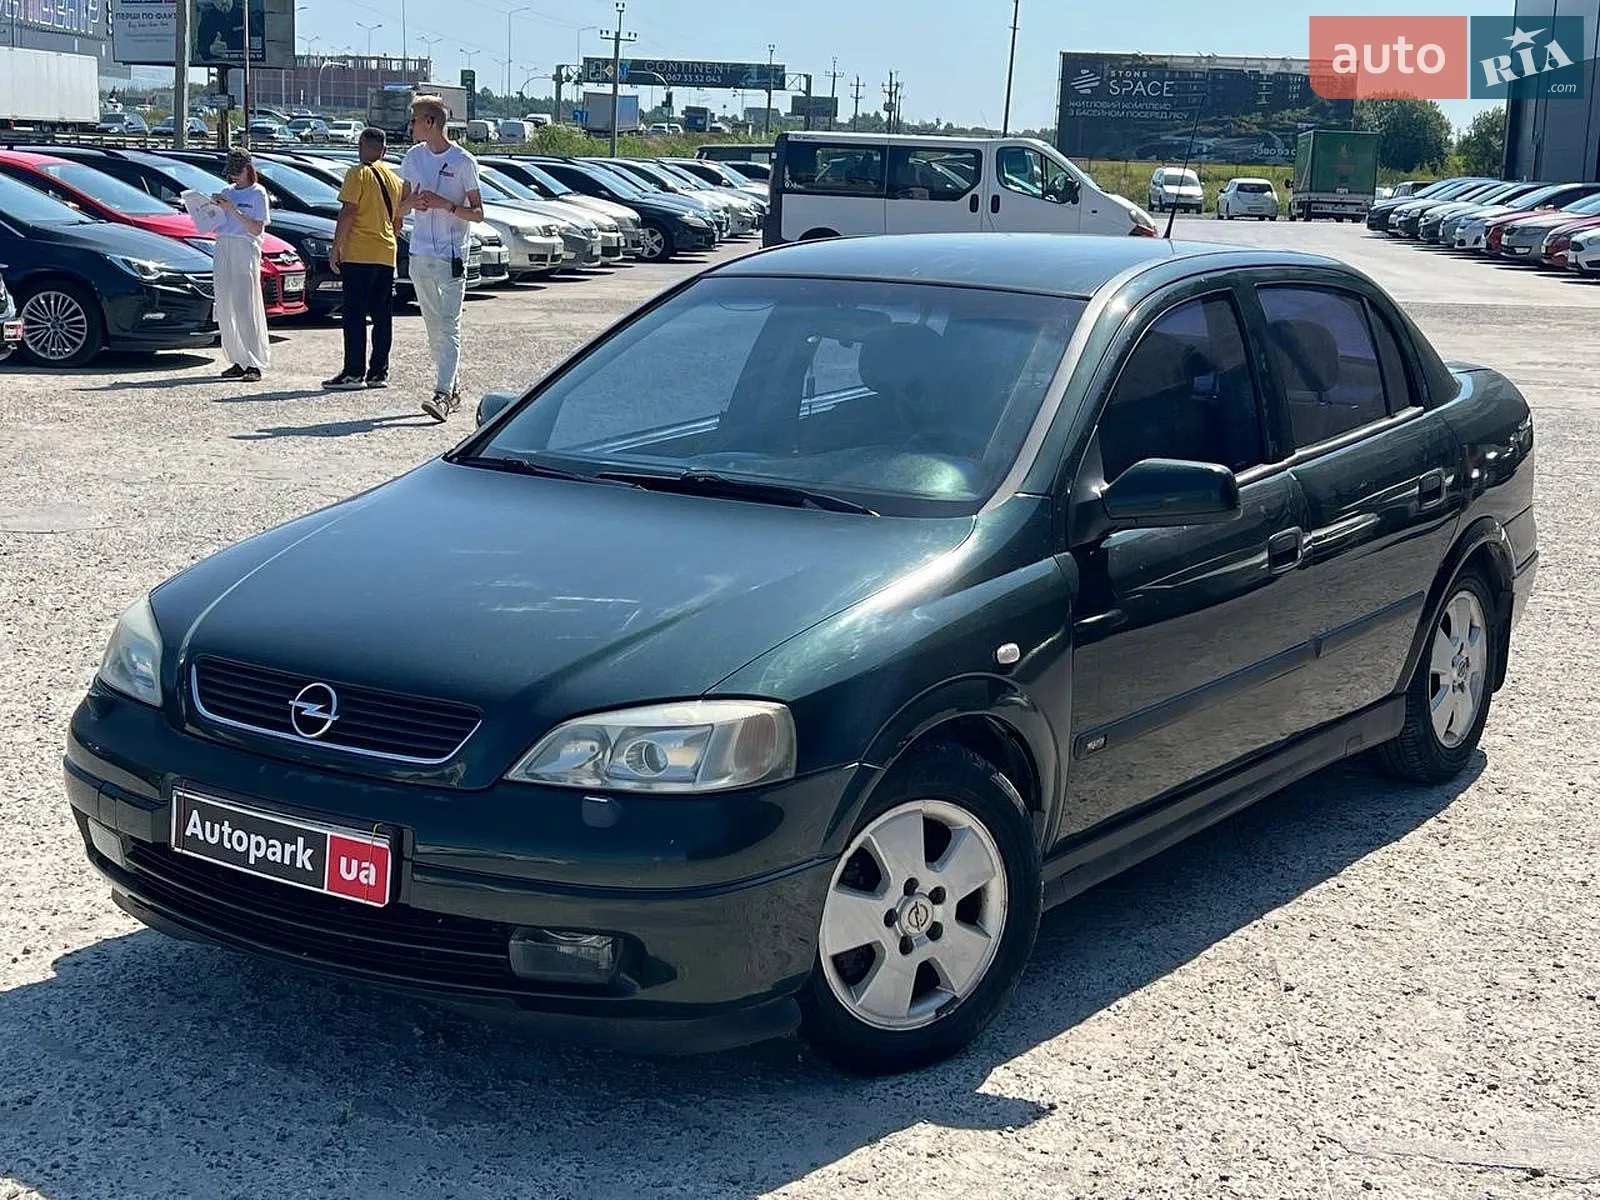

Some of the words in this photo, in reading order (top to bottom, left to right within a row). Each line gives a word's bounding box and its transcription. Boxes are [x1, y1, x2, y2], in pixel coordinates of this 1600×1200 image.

[142, 12, 154, 20] ПО
[644, 61, 732, 74] CONTINENT
[1111, 70, 1148, 78] STONE
[1109, 80, 1175, 97] SPACE
[185, 810, 313, 870] Autopark
[339, 856, 376, 886] ua
